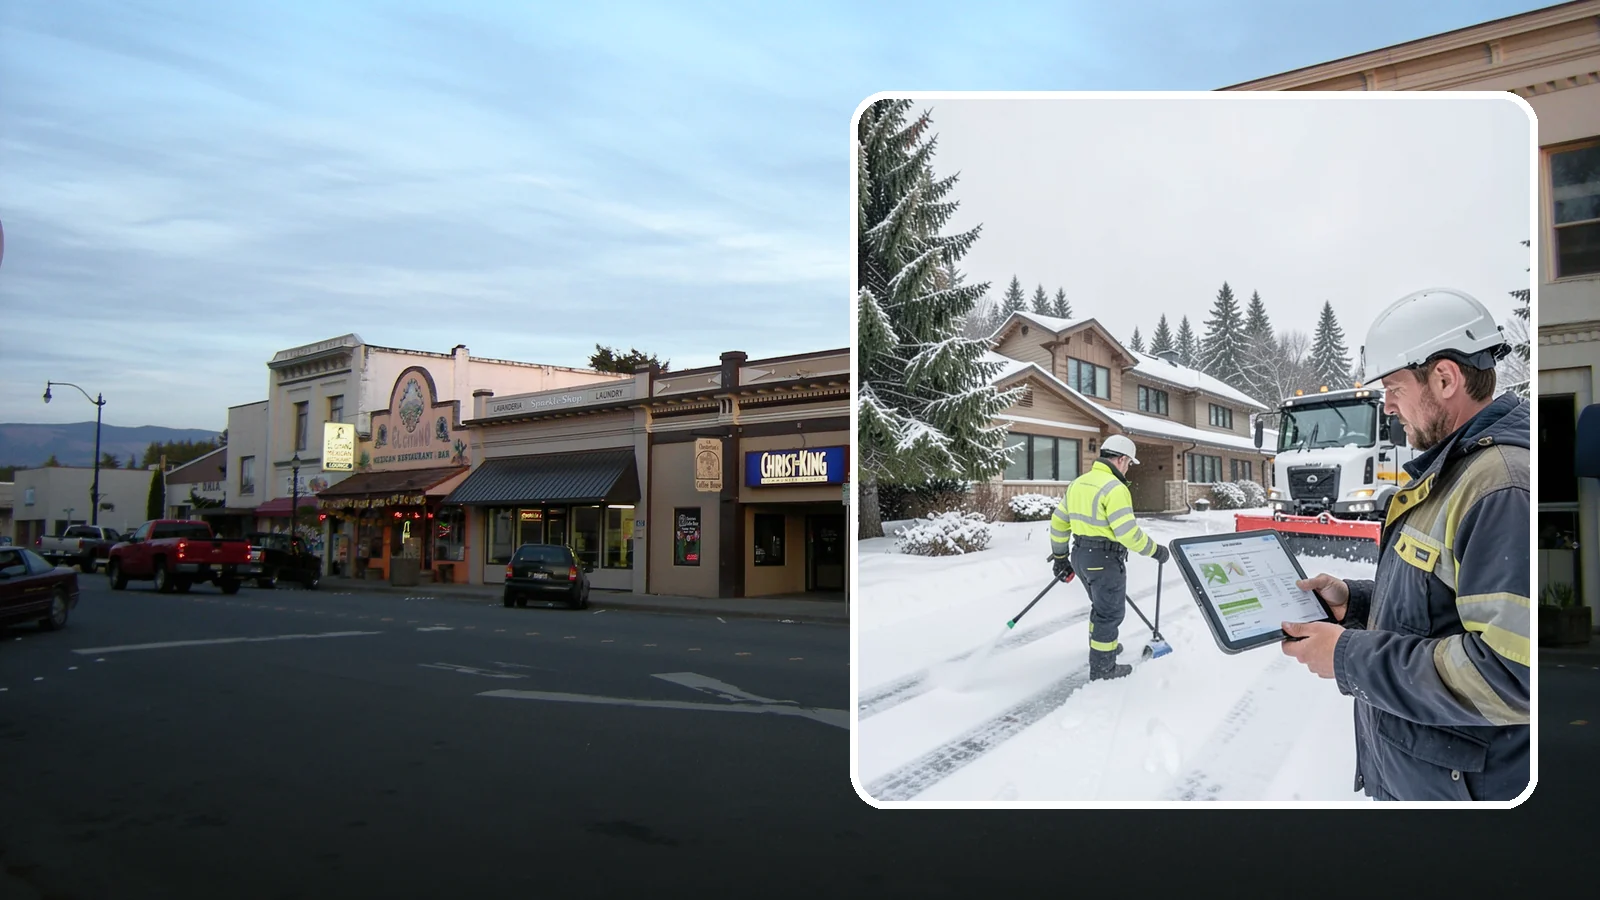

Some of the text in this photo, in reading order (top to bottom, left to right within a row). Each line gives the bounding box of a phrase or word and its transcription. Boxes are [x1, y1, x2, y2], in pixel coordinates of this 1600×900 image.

[562, 394, 582, 405] Shop
[595, 389, 623, 400] LAUNDRY
[493, 402, 522, 413] LAVANDERIA
[373, 450, 450, 464] MEXICAN RESTAURANT BAR
[761, 450, 827, 478] CHRIST KING
